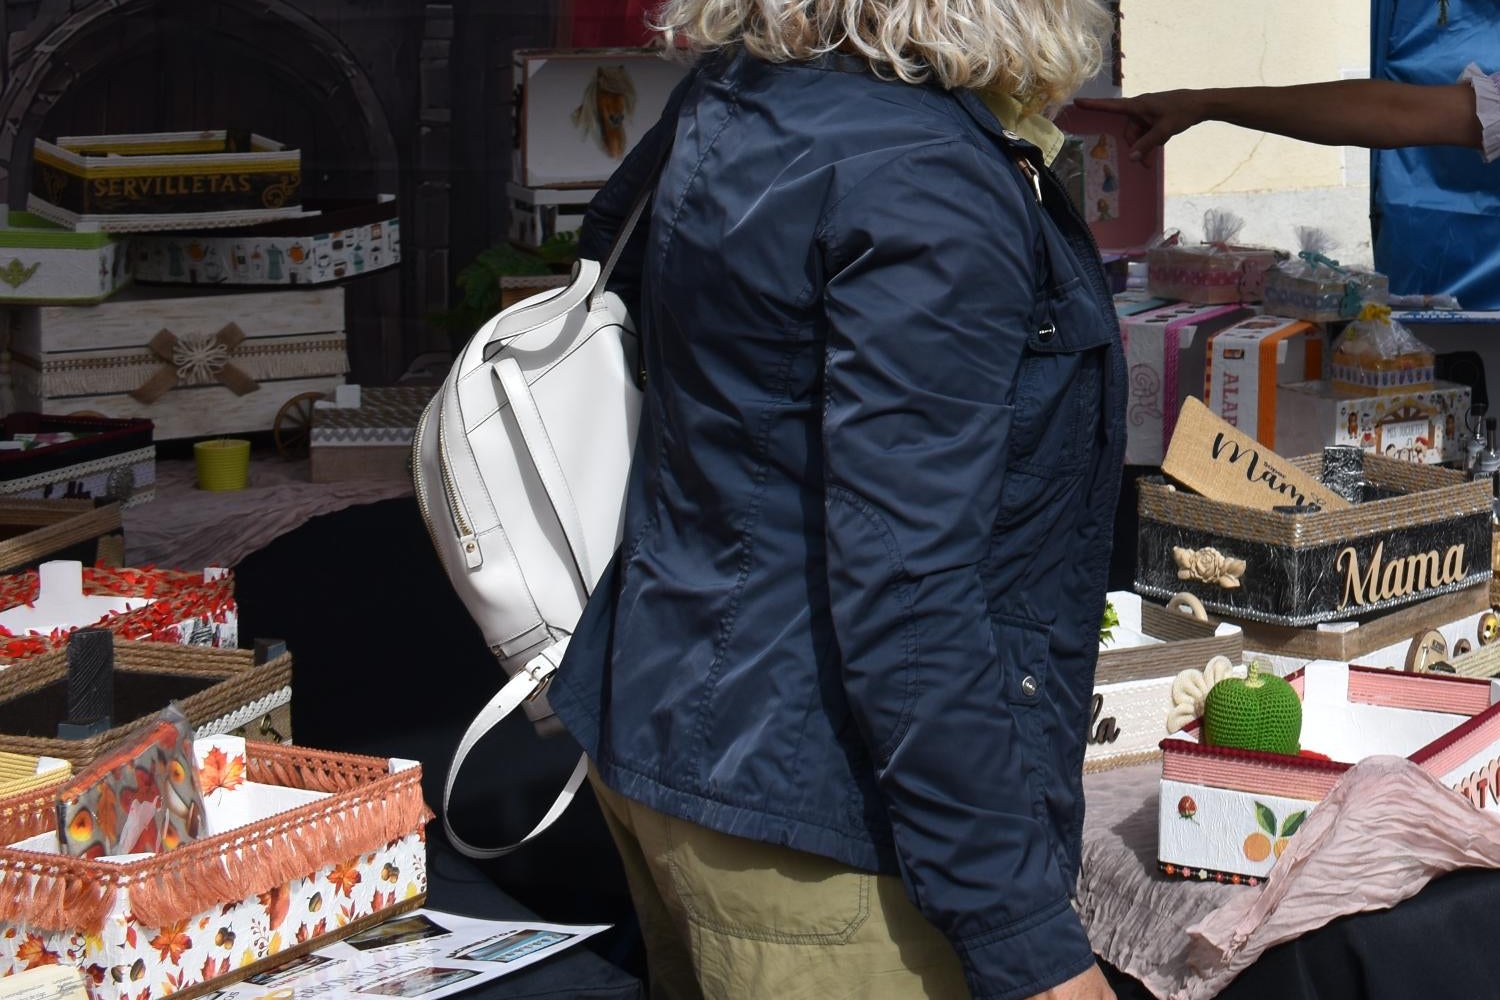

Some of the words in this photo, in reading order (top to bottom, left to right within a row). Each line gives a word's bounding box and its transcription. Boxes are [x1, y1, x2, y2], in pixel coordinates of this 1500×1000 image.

[95, 175, 250, 199] SERVILLETAS
[1212, 432, 1316, 508] Mam
[1336, 540, 1469, 611] Mama
